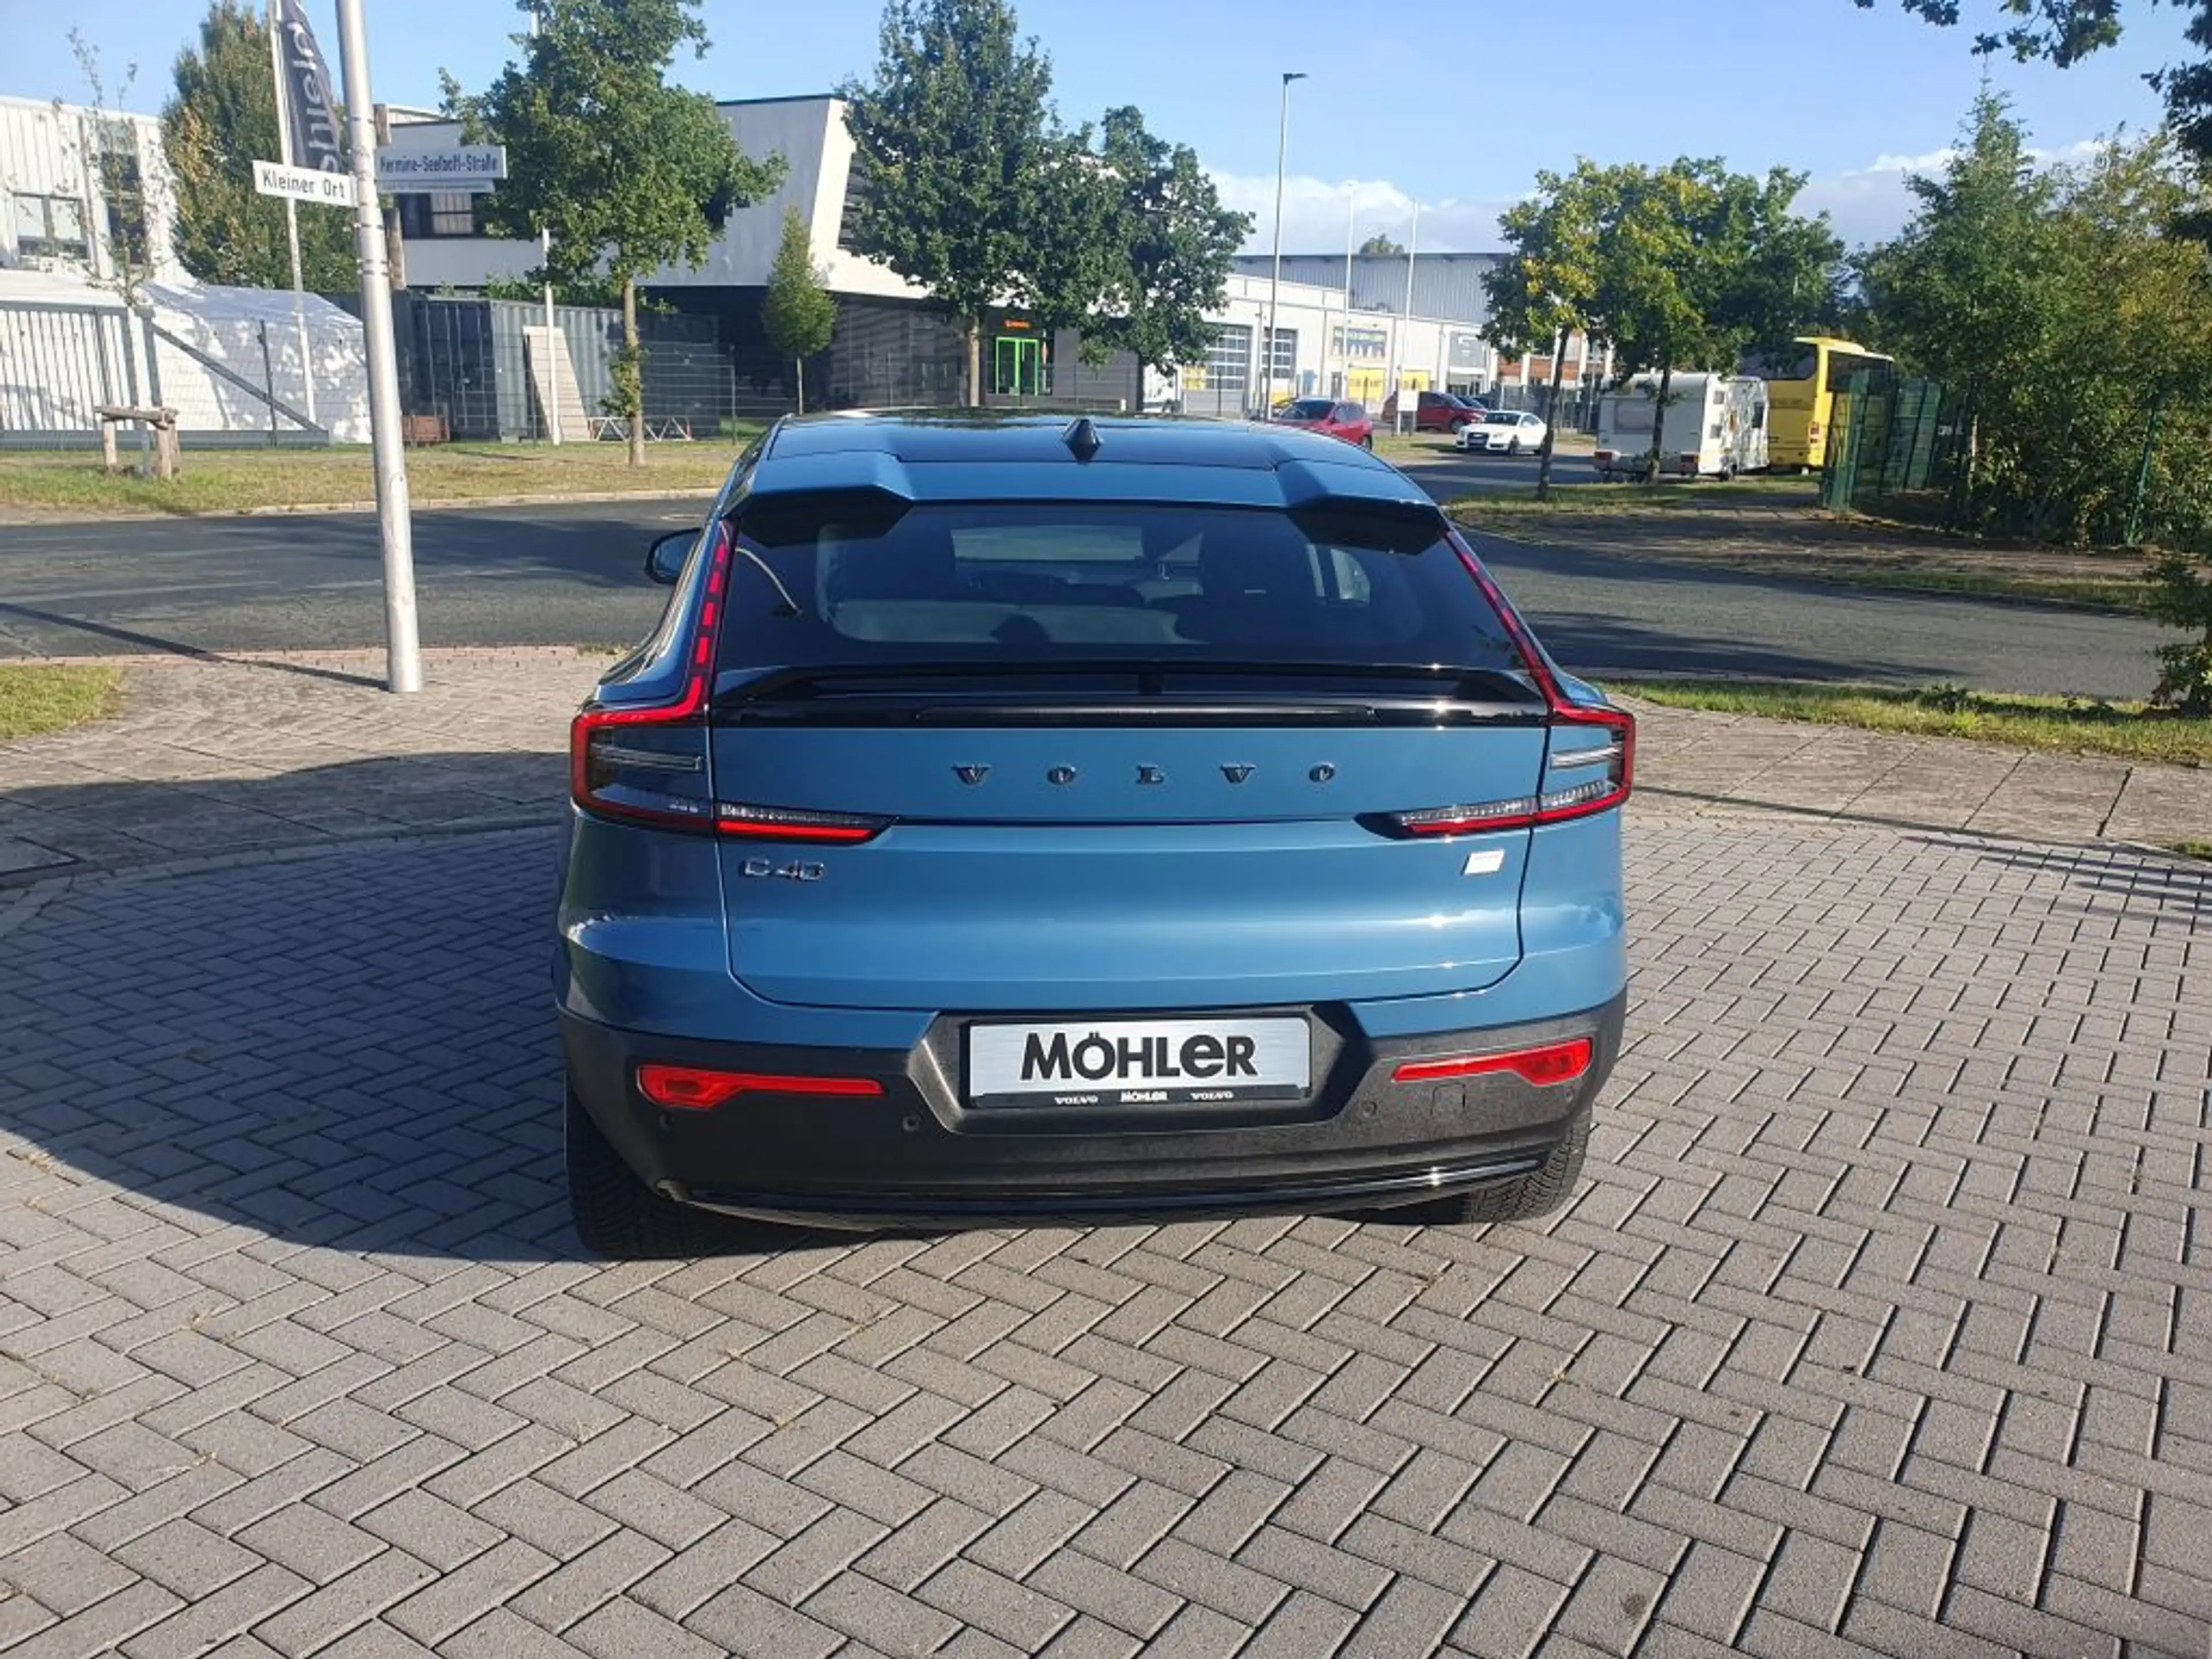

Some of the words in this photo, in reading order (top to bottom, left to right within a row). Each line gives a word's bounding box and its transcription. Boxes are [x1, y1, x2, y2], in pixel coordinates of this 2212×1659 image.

[263, 169, 315, 194] Kleiner
[323, 181, 346, 198] Ort
[952, 762, 1335, 786] VOLVO
[743, 857, 826, 881] C40
[1054, 1095, 1099, 1105] VOLVO
[1190, 1091, 1234, 1101] VOLVO
